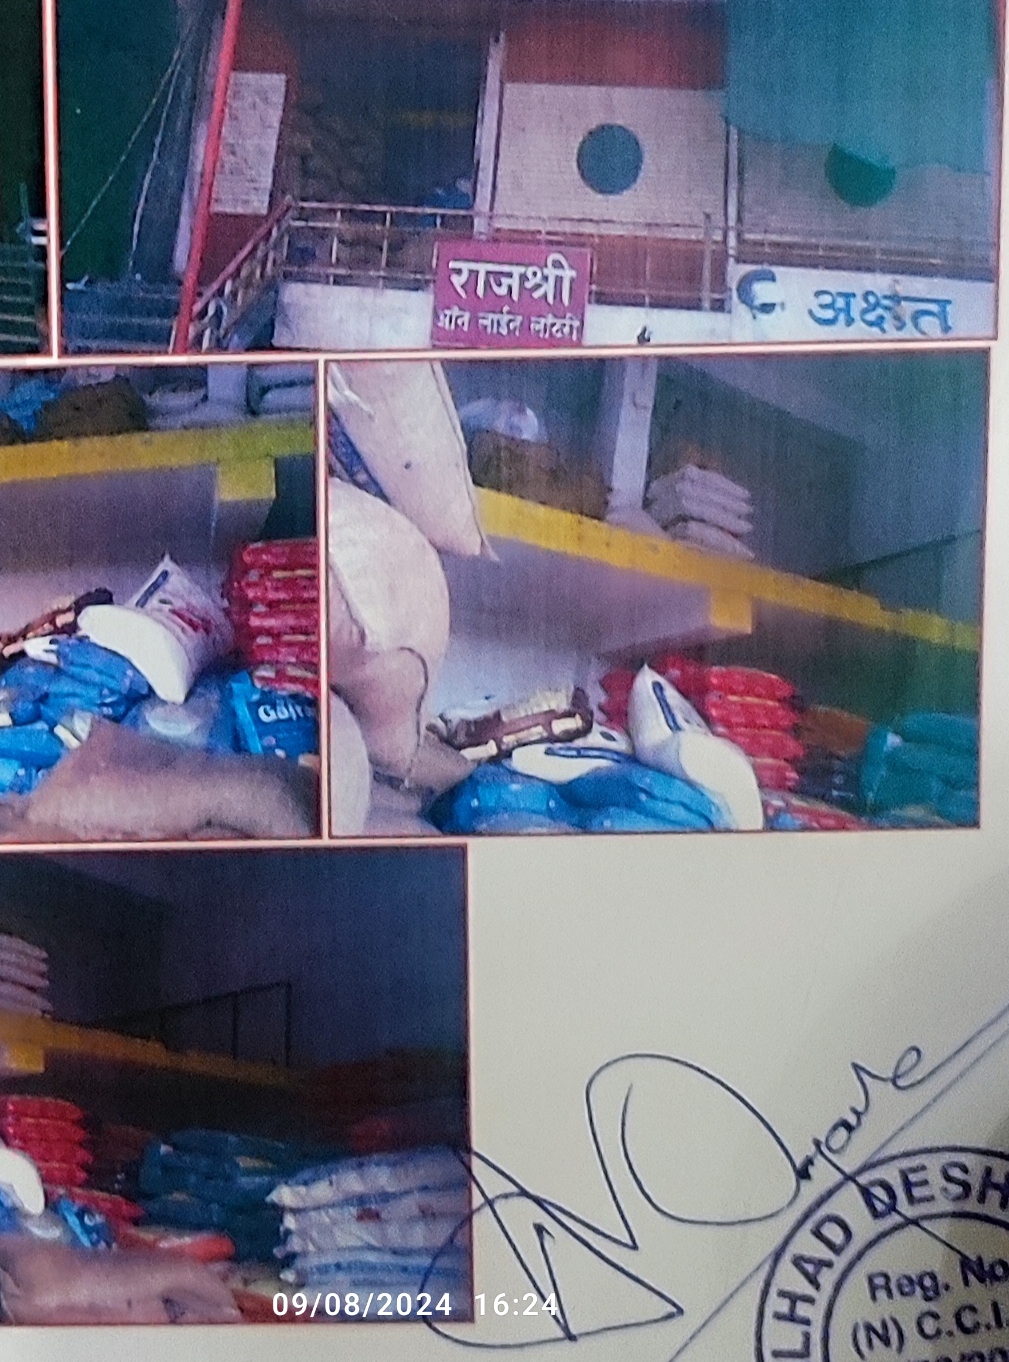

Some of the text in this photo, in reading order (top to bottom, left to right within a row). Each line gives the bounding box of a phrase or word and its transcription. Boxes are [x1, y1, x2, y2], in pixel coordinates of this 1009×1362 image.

[448, 251, 577, 306] राजश्री
[806, 286, 953, 335] अक्षत
[851, 1315, 906, 1361] (N)
